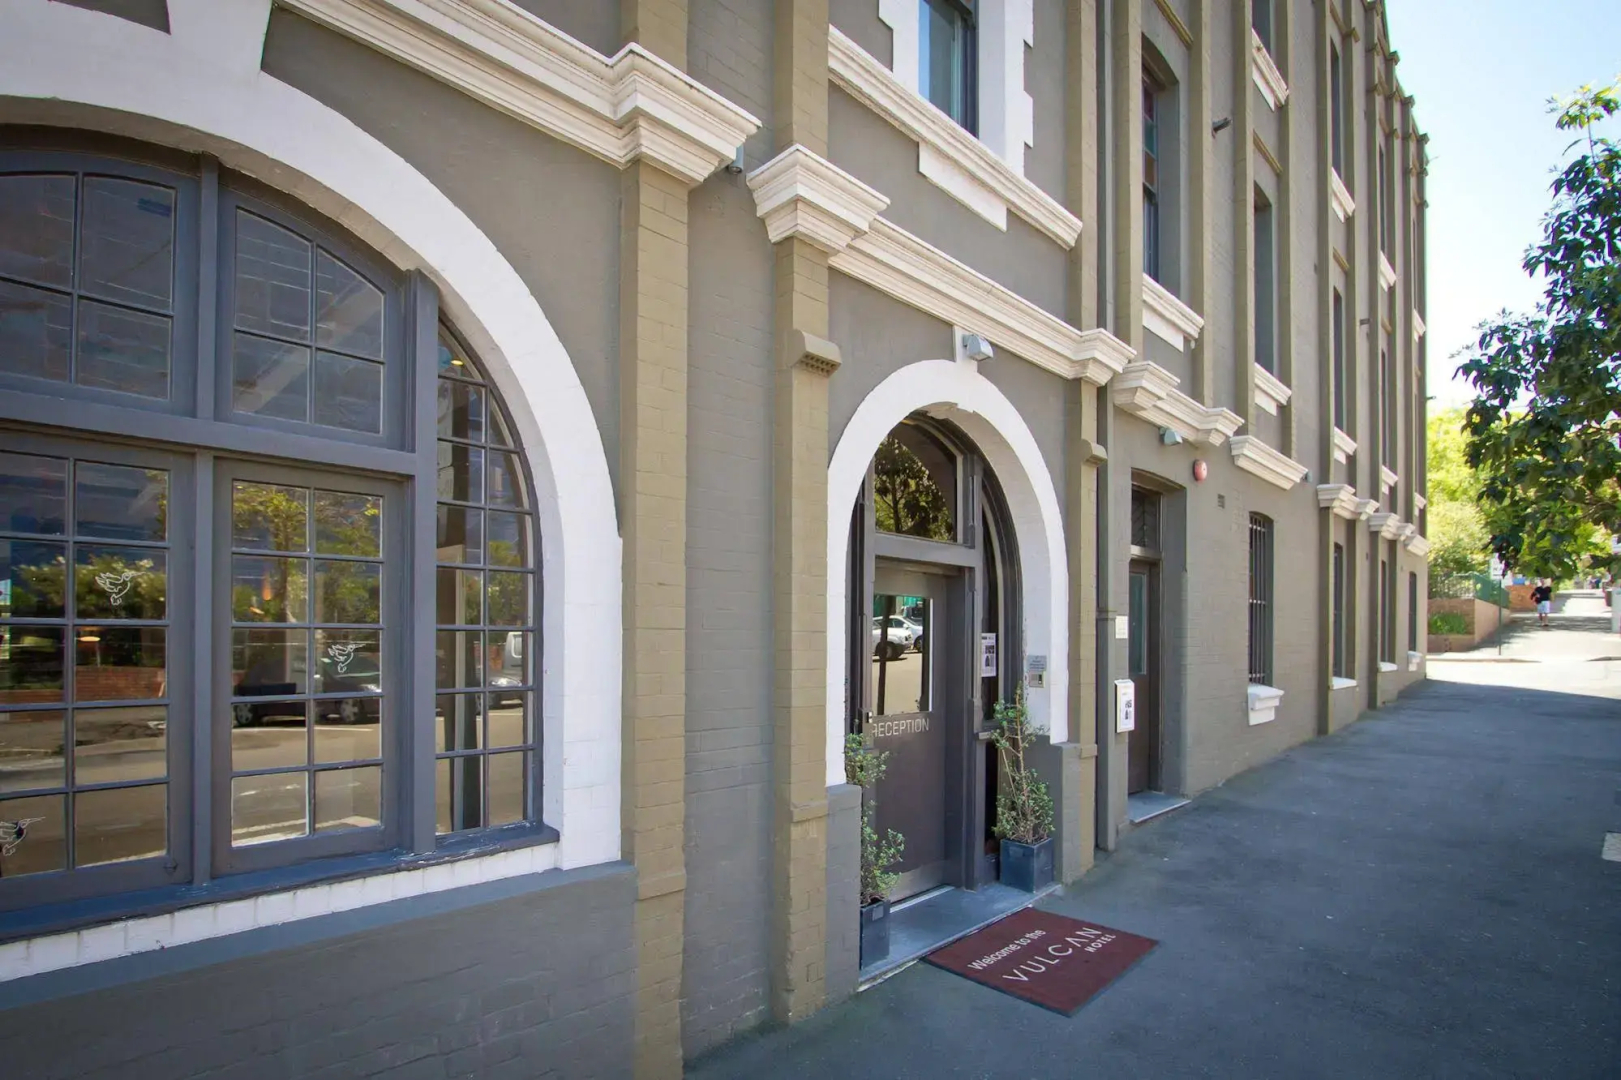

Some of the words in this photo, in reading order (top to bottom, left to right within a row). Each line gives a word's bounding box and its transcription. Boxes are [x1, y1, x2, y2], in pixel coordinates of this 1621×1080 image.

[872, 718, 930, 737] RECEPTION
[967, 943, 1021, 970] Welcome
[1014, 937, 1032, 946] to
[1024, 929, 1047, 940] the
[1002, 927, 1102, 981] VULCAN
[1084, 934, 1117, 953] HOTEL
